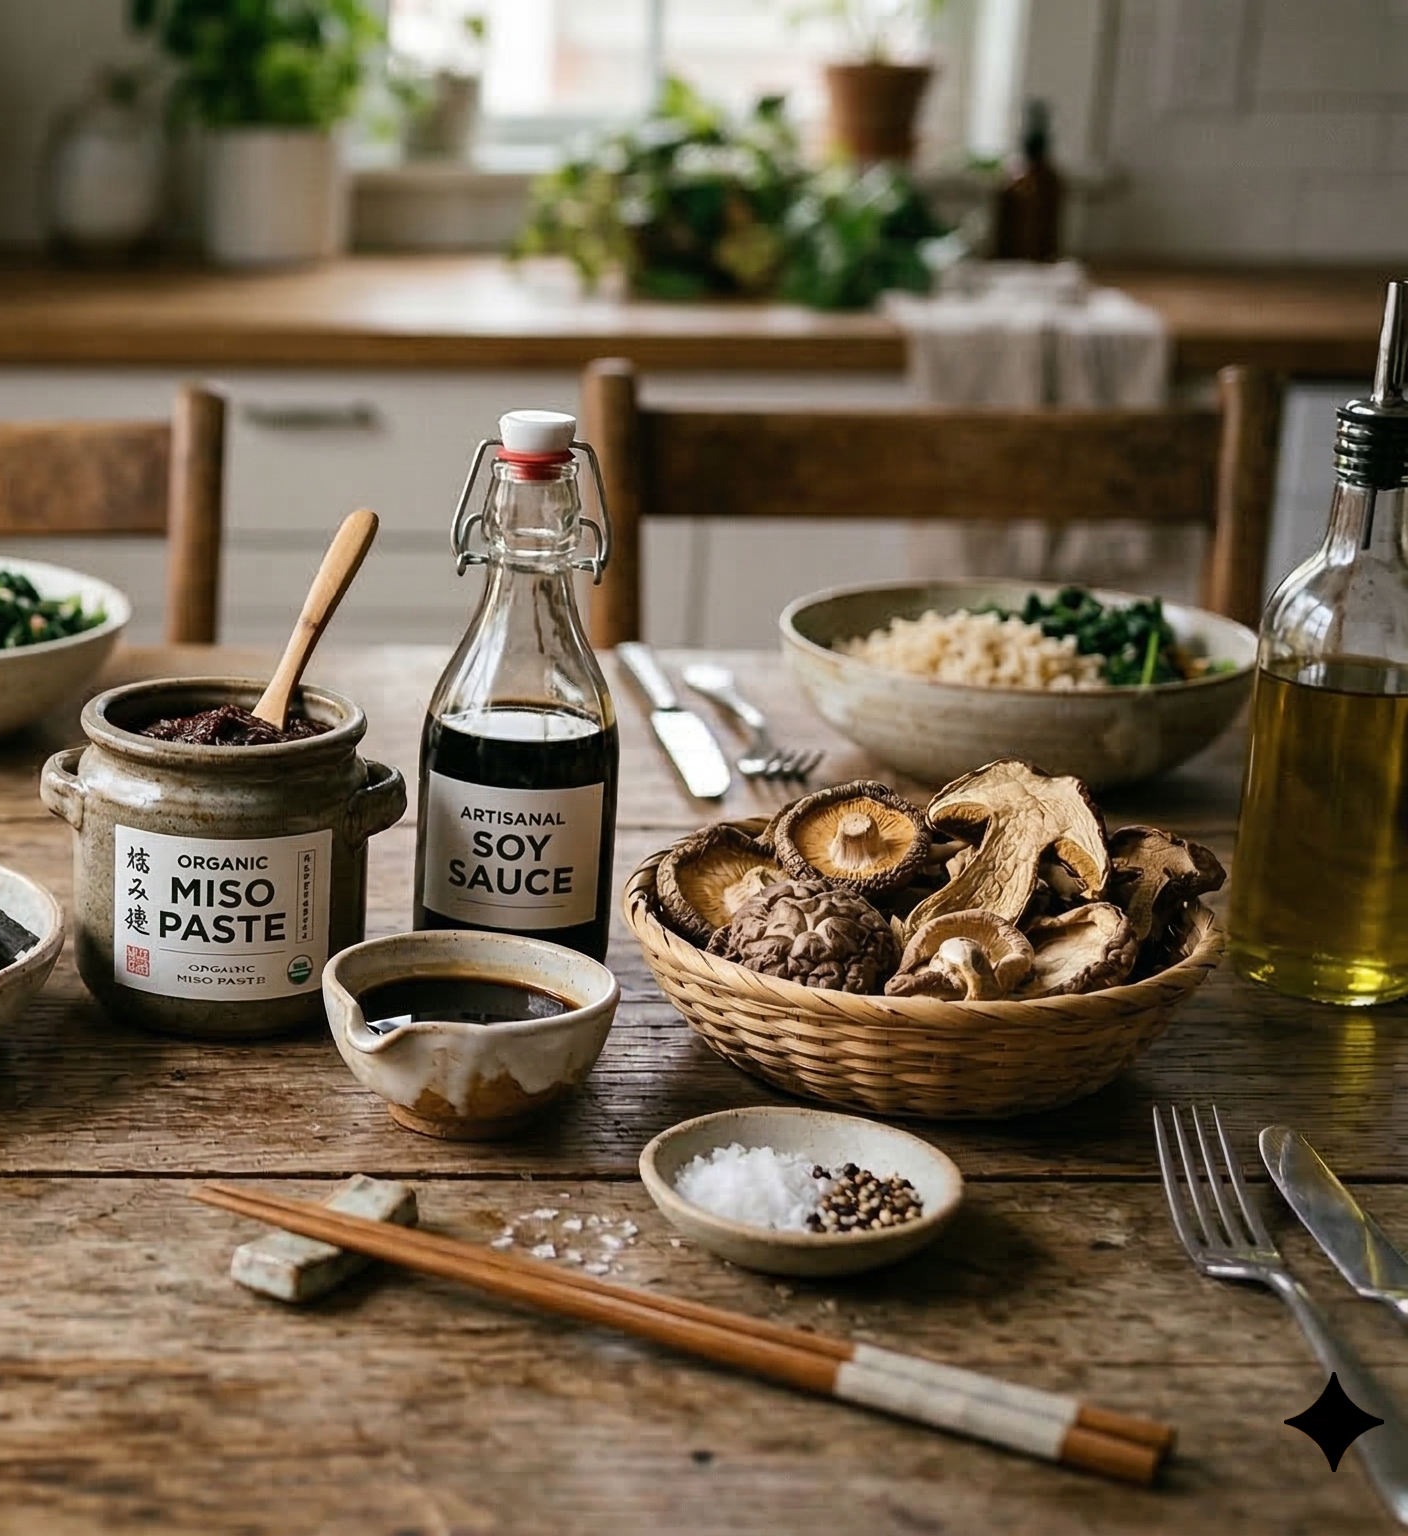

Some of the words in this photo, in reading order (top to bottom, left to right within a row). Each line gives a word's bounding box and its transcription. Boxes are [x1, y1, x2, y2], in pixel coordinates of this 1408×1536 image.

[460, 806, 566, 827] ARTISANAL
[472, 830, 553, 861] SOY
[177, 854, 269, 871] ORGANIC
[448, 858, 574, 896] SAUCE
[170, 876, 275, 909] MISO
[159, 910, 286, 944] PASTE
[177, 974, 213, 985] MISO
